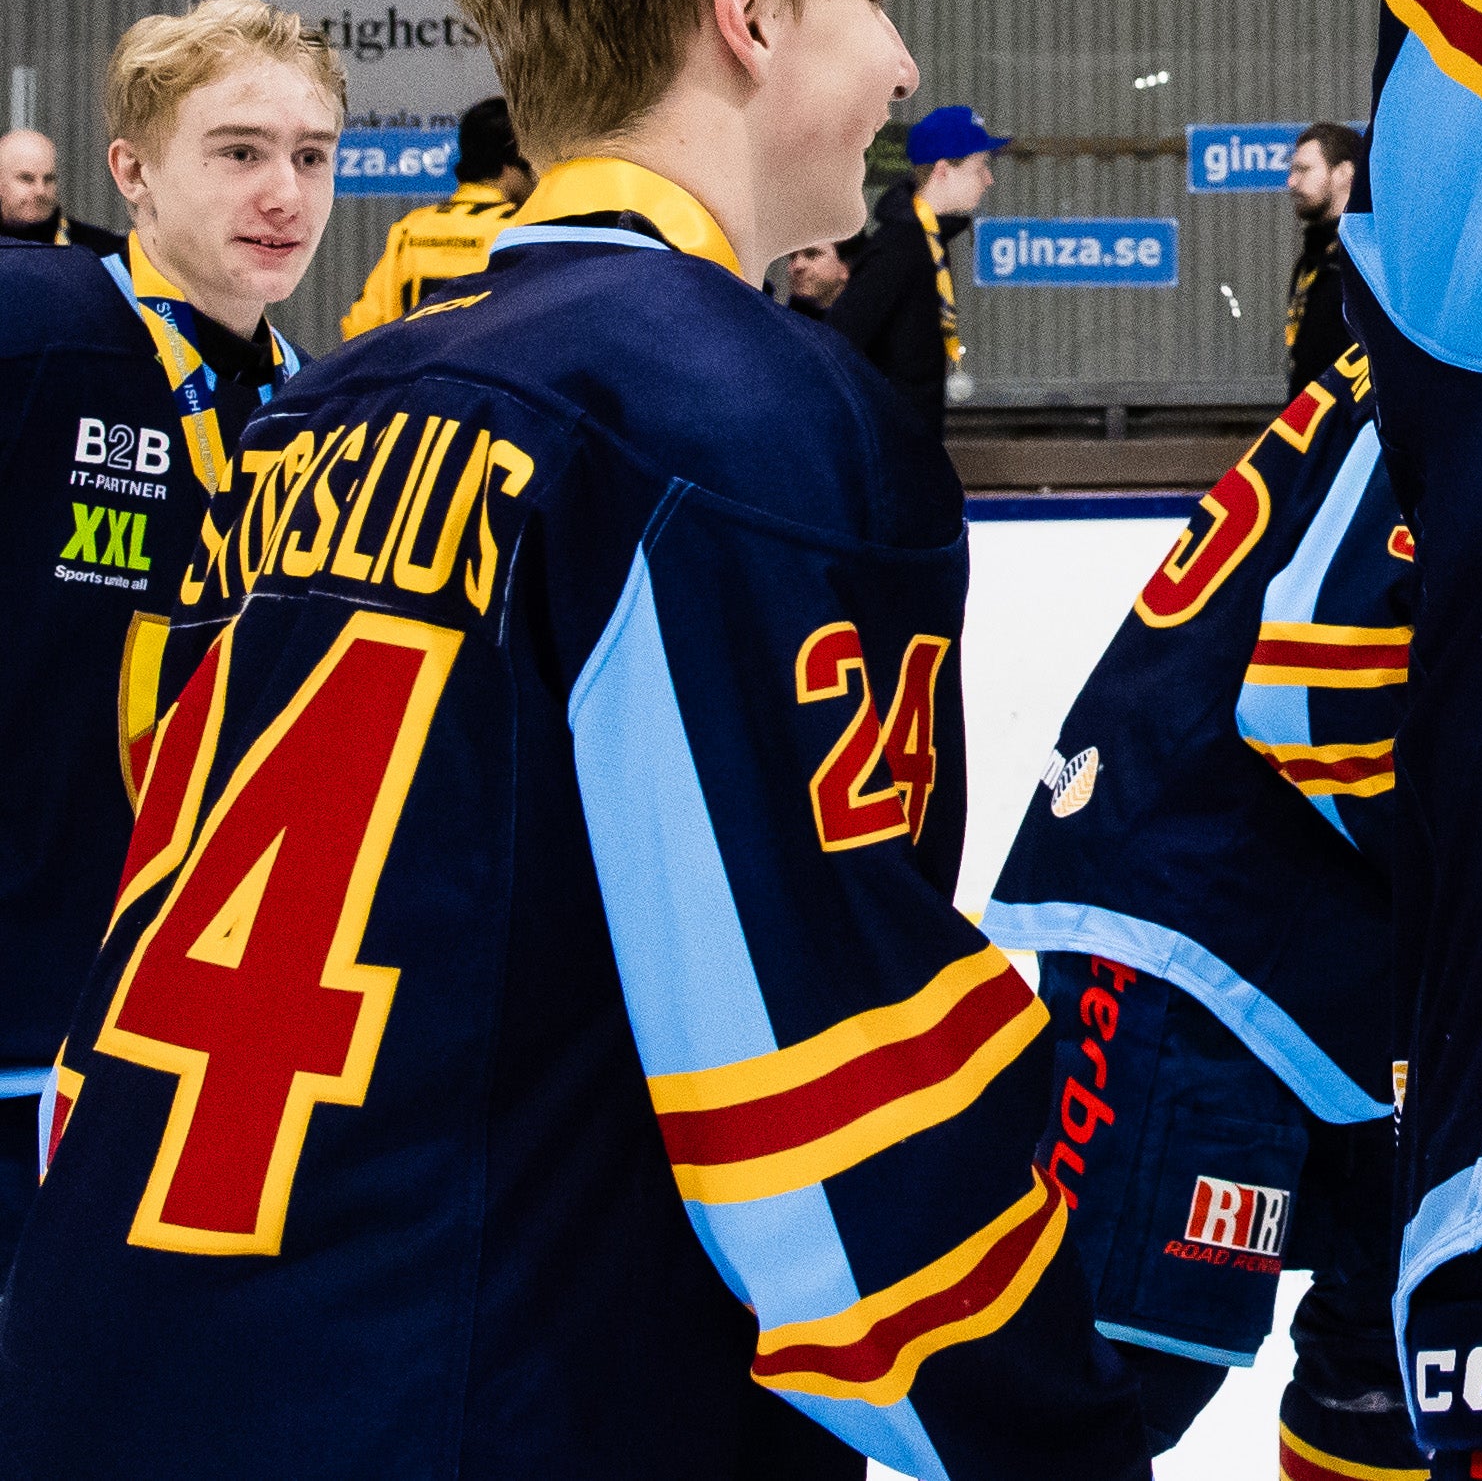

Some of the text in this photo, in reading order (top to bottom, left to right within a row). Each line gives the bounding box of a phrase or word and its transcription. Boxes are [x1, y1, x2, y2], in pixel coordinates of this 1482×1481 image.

[338, 143, 450, 177] za.se
[1203, 136, 1291, 183] ginz
[990, 229, 1162, 276] ginza.se
[74, 417, 171, 475] B2B
[69, 470, 168, 500] IT-PARTNER
[60, 502, 151, 571] XXL
[54, 564, 102, 585] Sports
[131, 578, 149, 591] all
[795, 620, 952, 853] 24
[1163, 1240, 1230, 1265] ROAD
